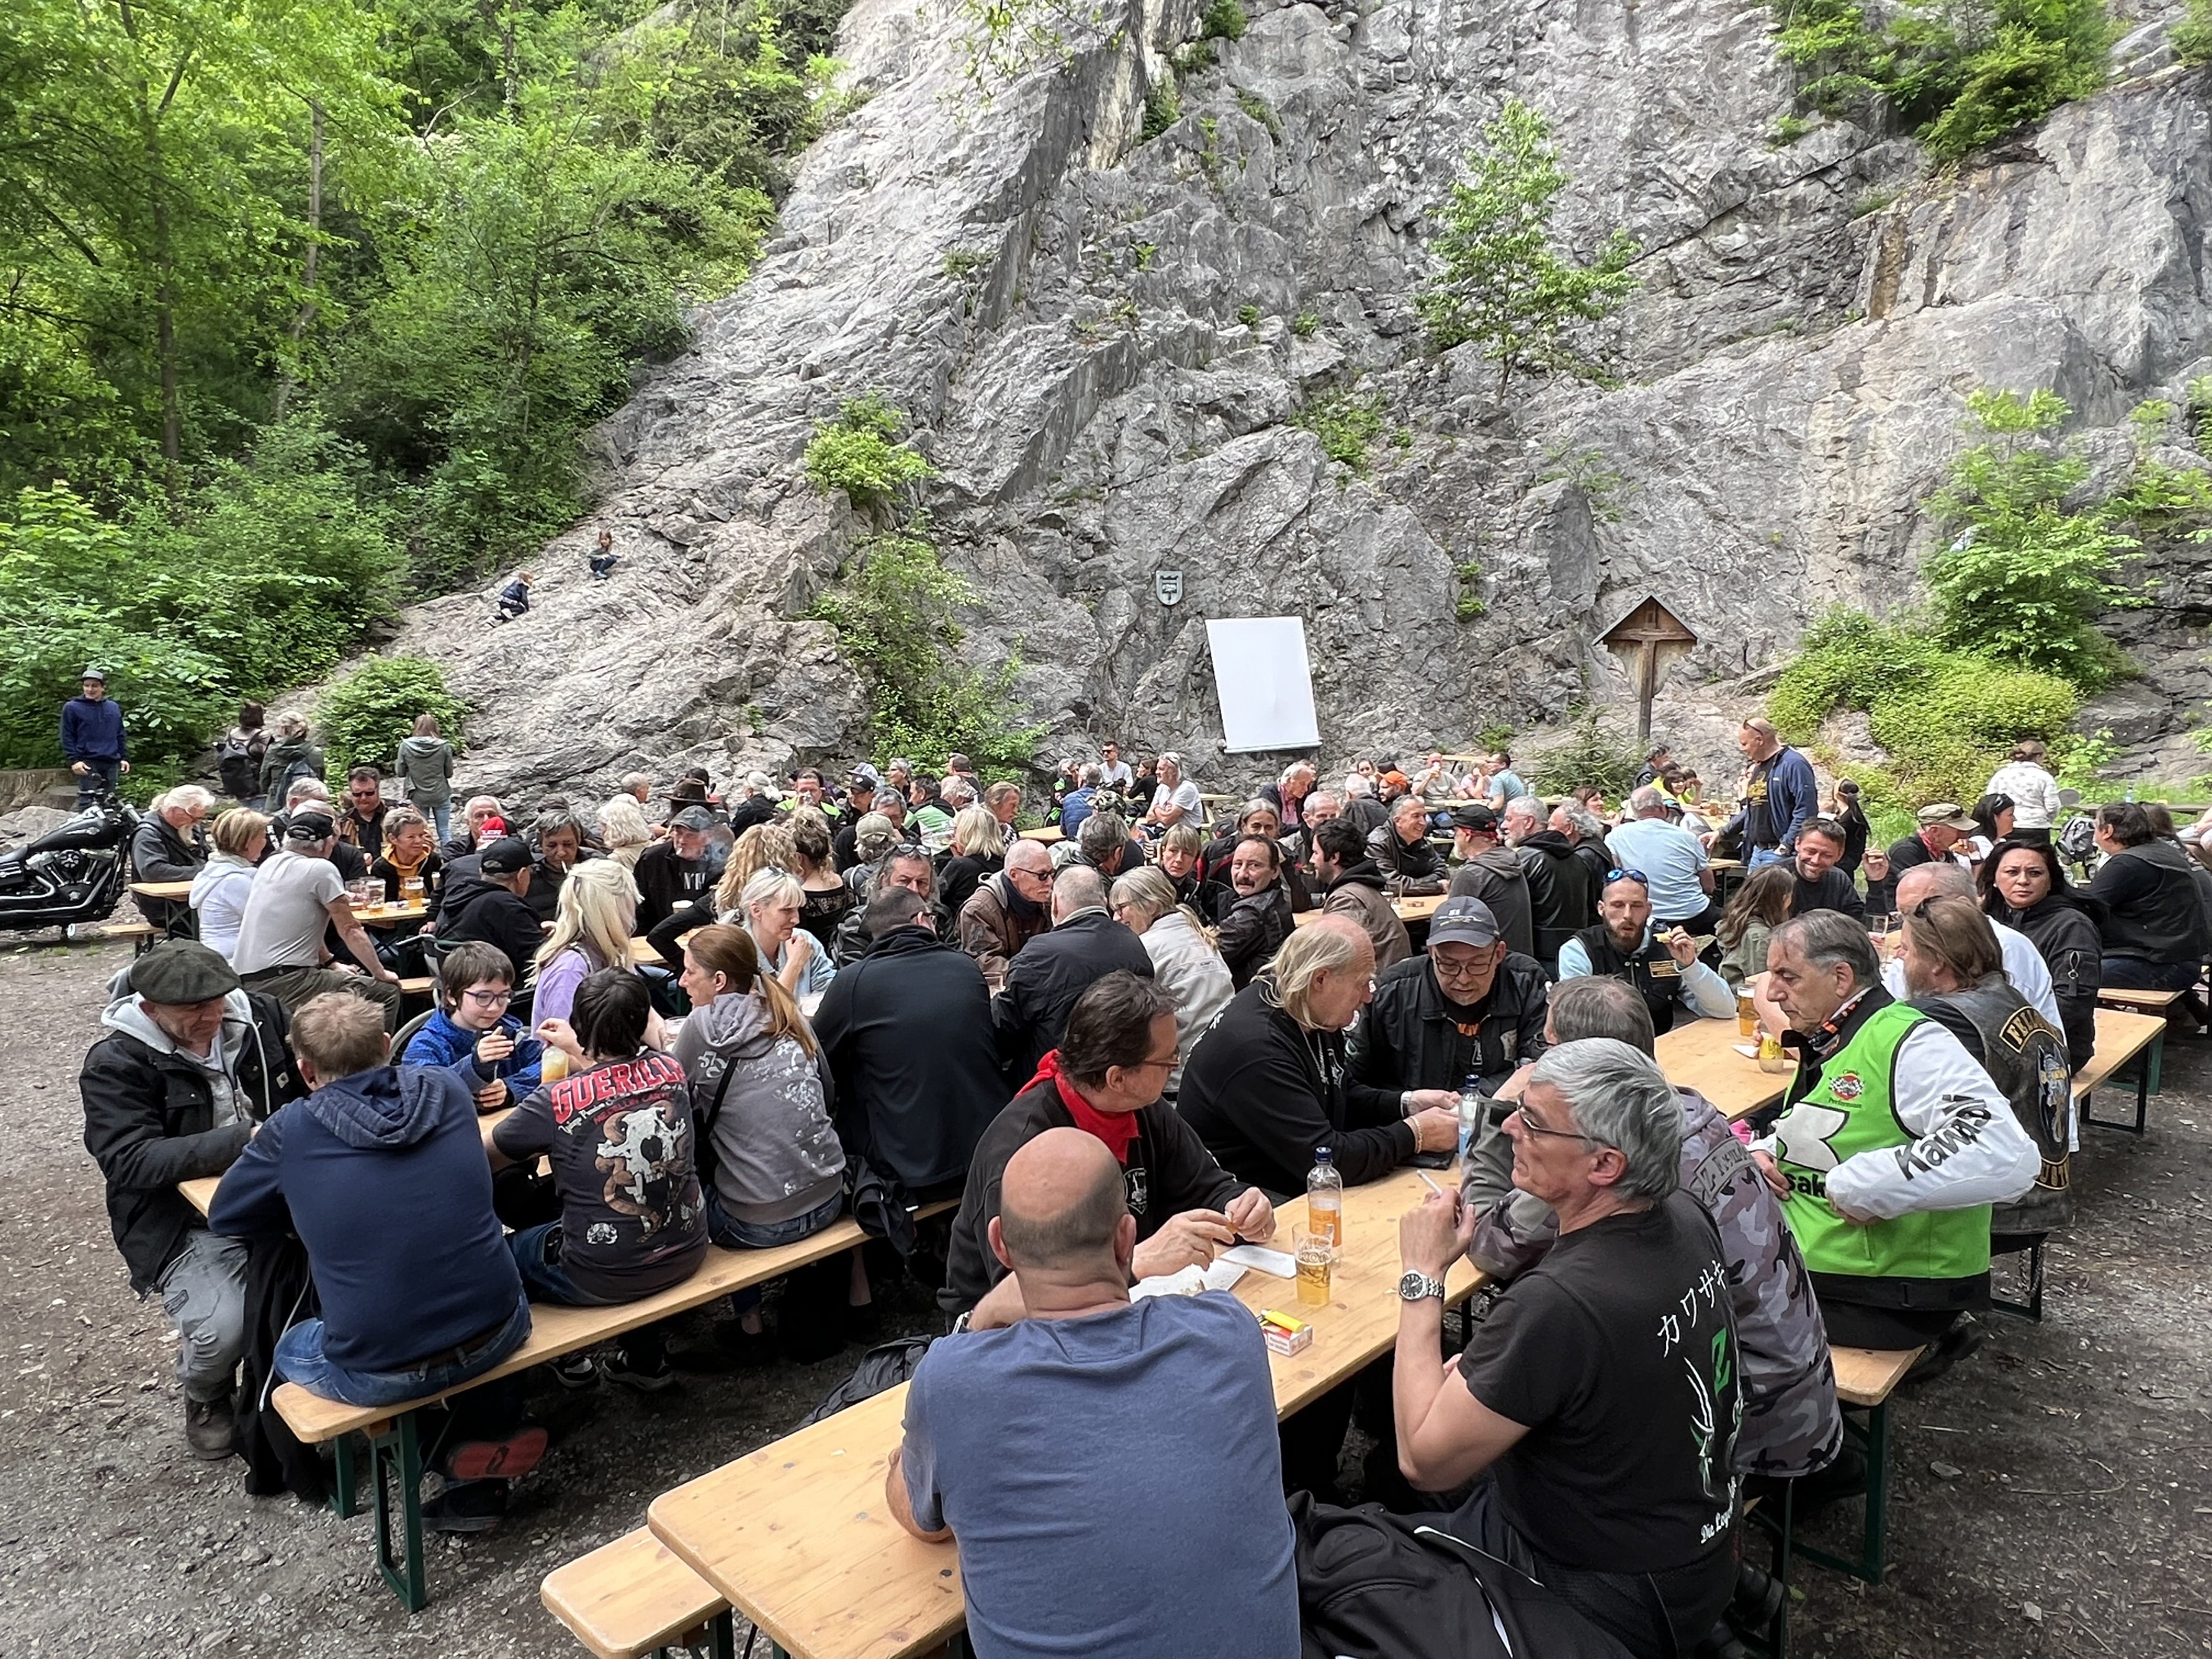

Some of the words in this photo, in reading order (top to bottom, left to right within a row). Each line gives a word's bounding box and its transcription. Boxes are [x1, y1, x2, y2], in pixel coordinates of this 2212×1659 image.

[2006, 1009, 2061, 1045] FELL
[1657, 1260, 1726, 1358] カワサキ
